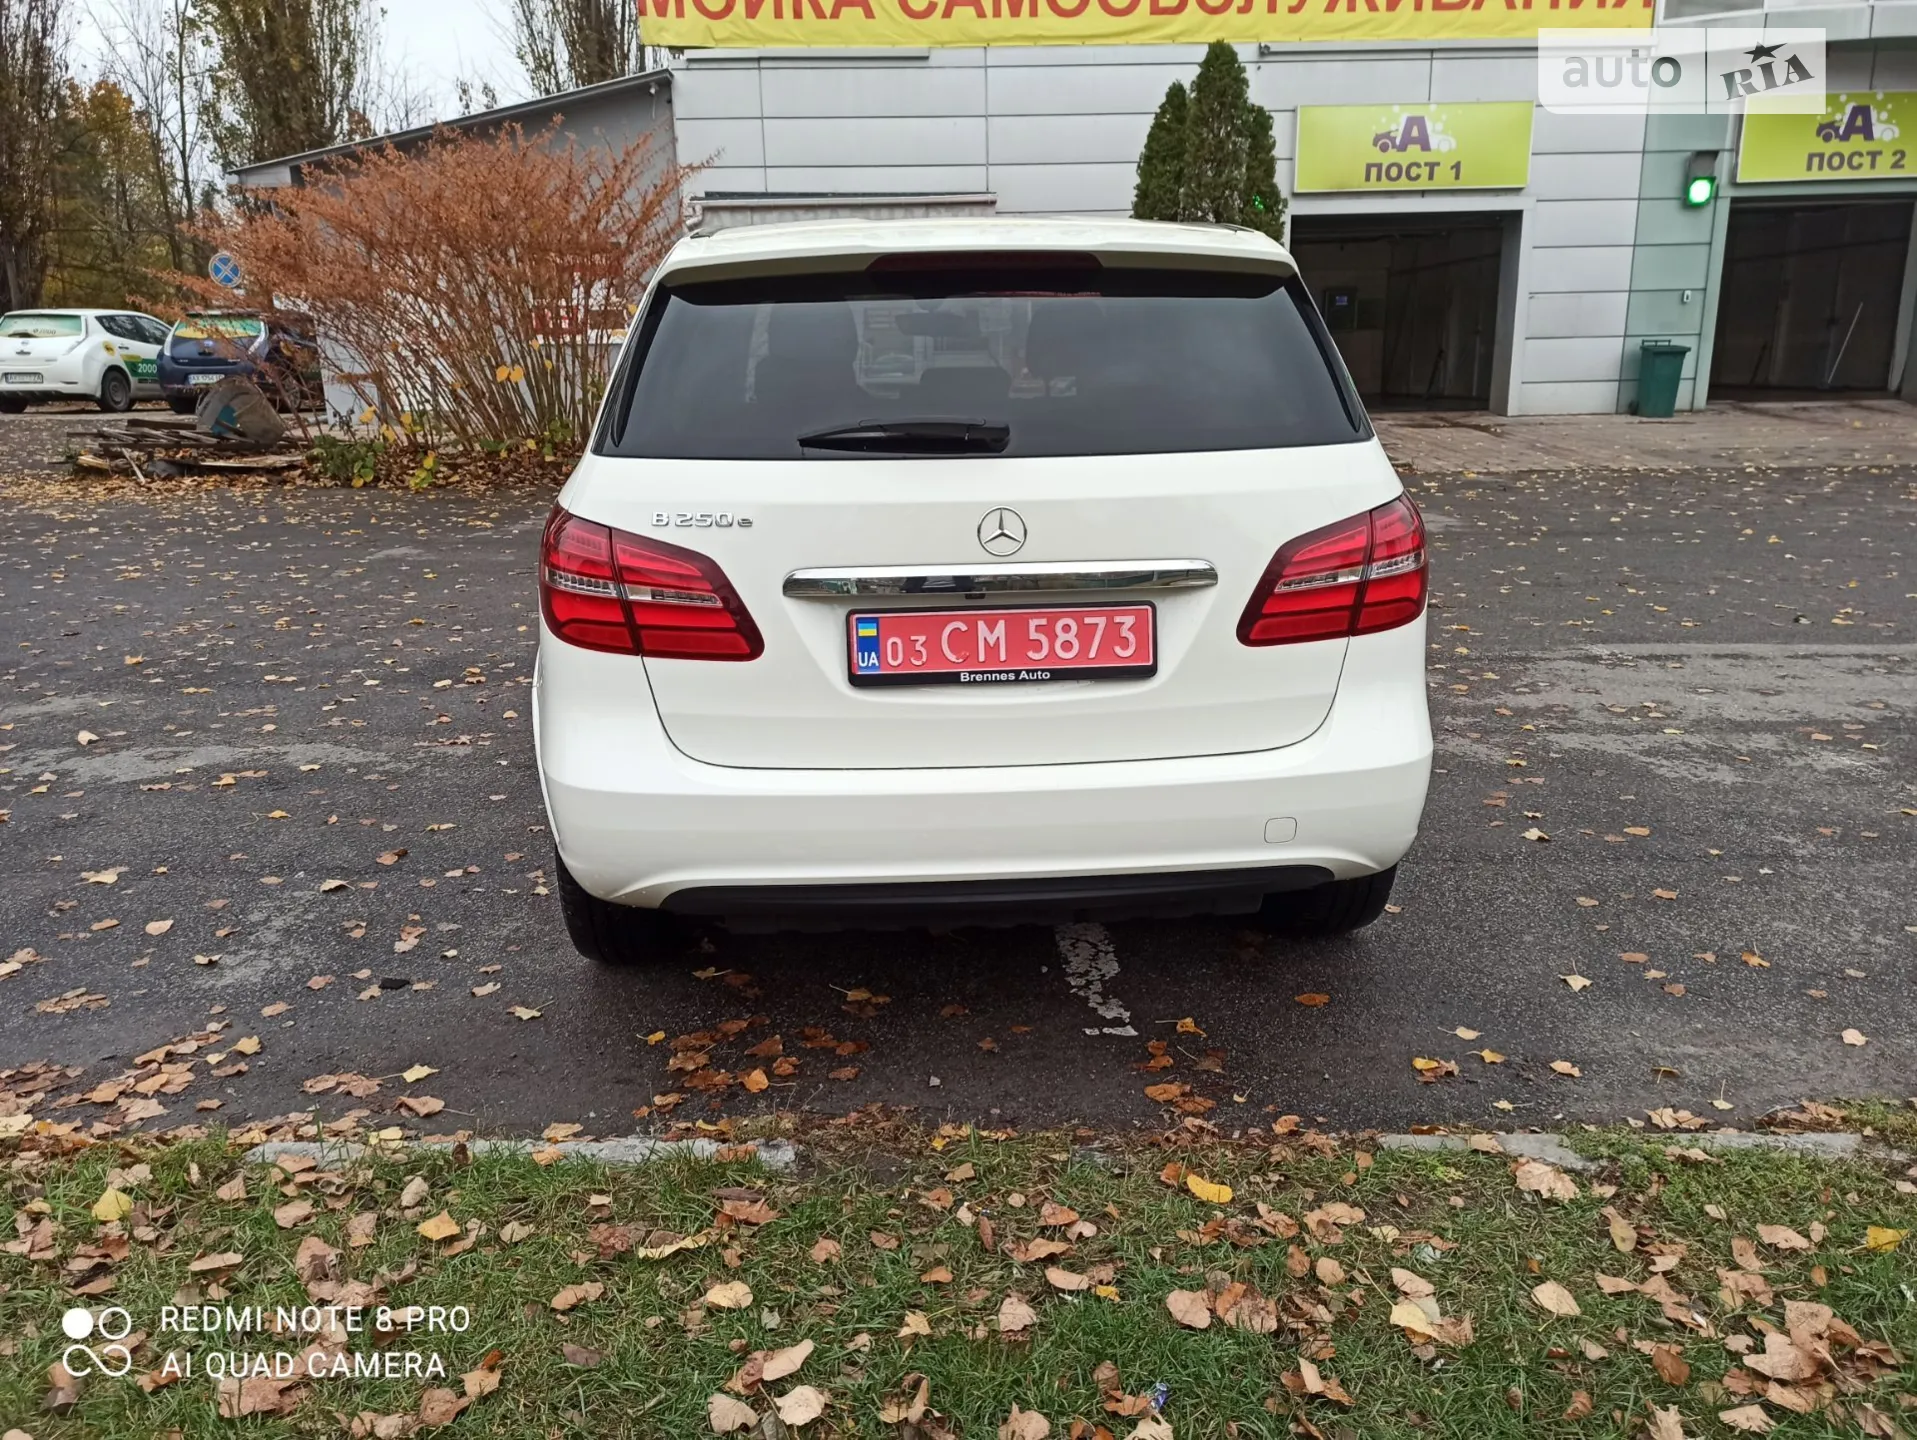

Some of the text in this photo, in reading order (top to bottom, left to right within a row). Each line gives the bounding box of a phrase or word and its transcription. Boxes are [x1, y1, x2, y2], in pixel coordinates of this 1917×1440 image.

[1806, 149, 1907, 173] ПОСТ 2
[1364, 160, 1462, 183] ПОСТ 1
[137, 363, 158, 374] 2000
[651, 511, 670, 527] B
[886, 615, 1137, 667] 03 CM 5873
[858, 651, 880, 667] UA
[960, 670, 1051, 682] Brennes Auto
